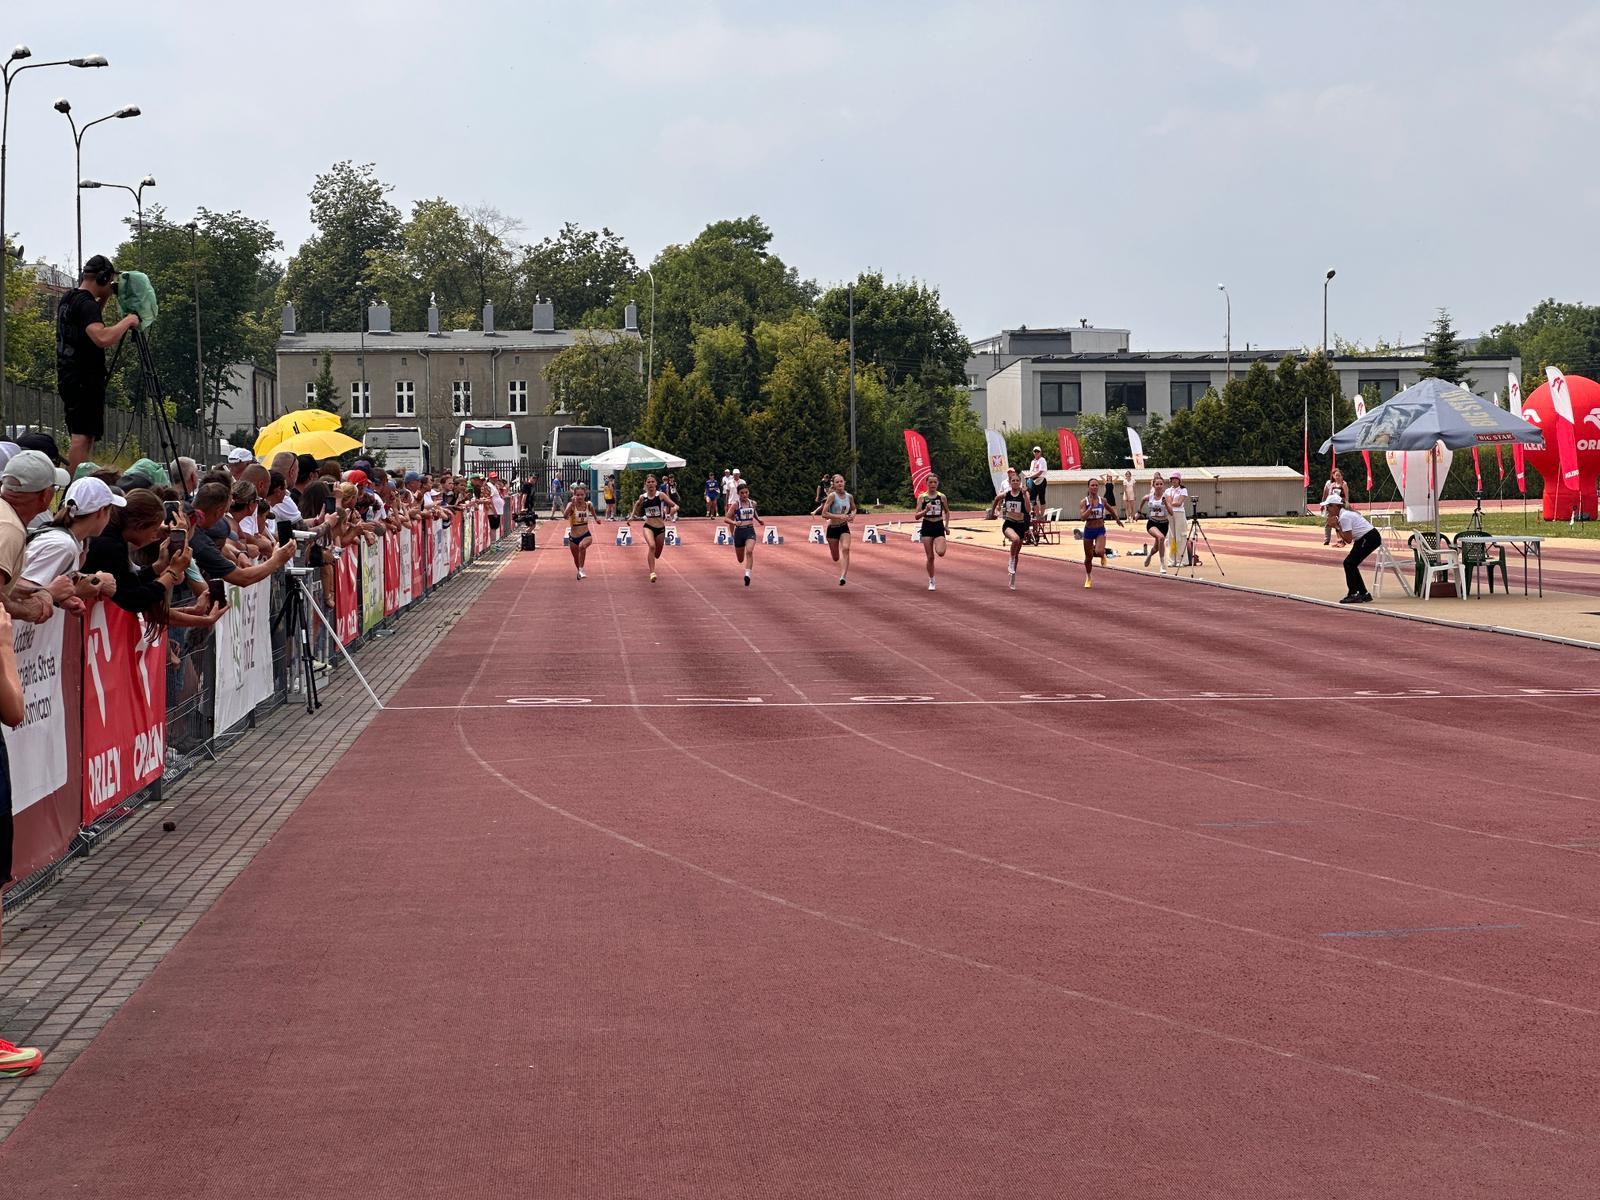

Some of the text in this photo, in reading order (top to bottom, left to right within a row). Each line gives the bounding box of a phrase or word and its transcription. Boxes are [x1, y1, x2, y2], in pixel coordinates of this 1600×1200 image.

[1492, 433, 1513, 441] STAR
[620, 531, 628, 542] 7
[667, 530, 675, 541] 6
[719, 530, 727, 541] 5
[814, 530, 821, 540] 3
[867, 529, 875, 540] 2
